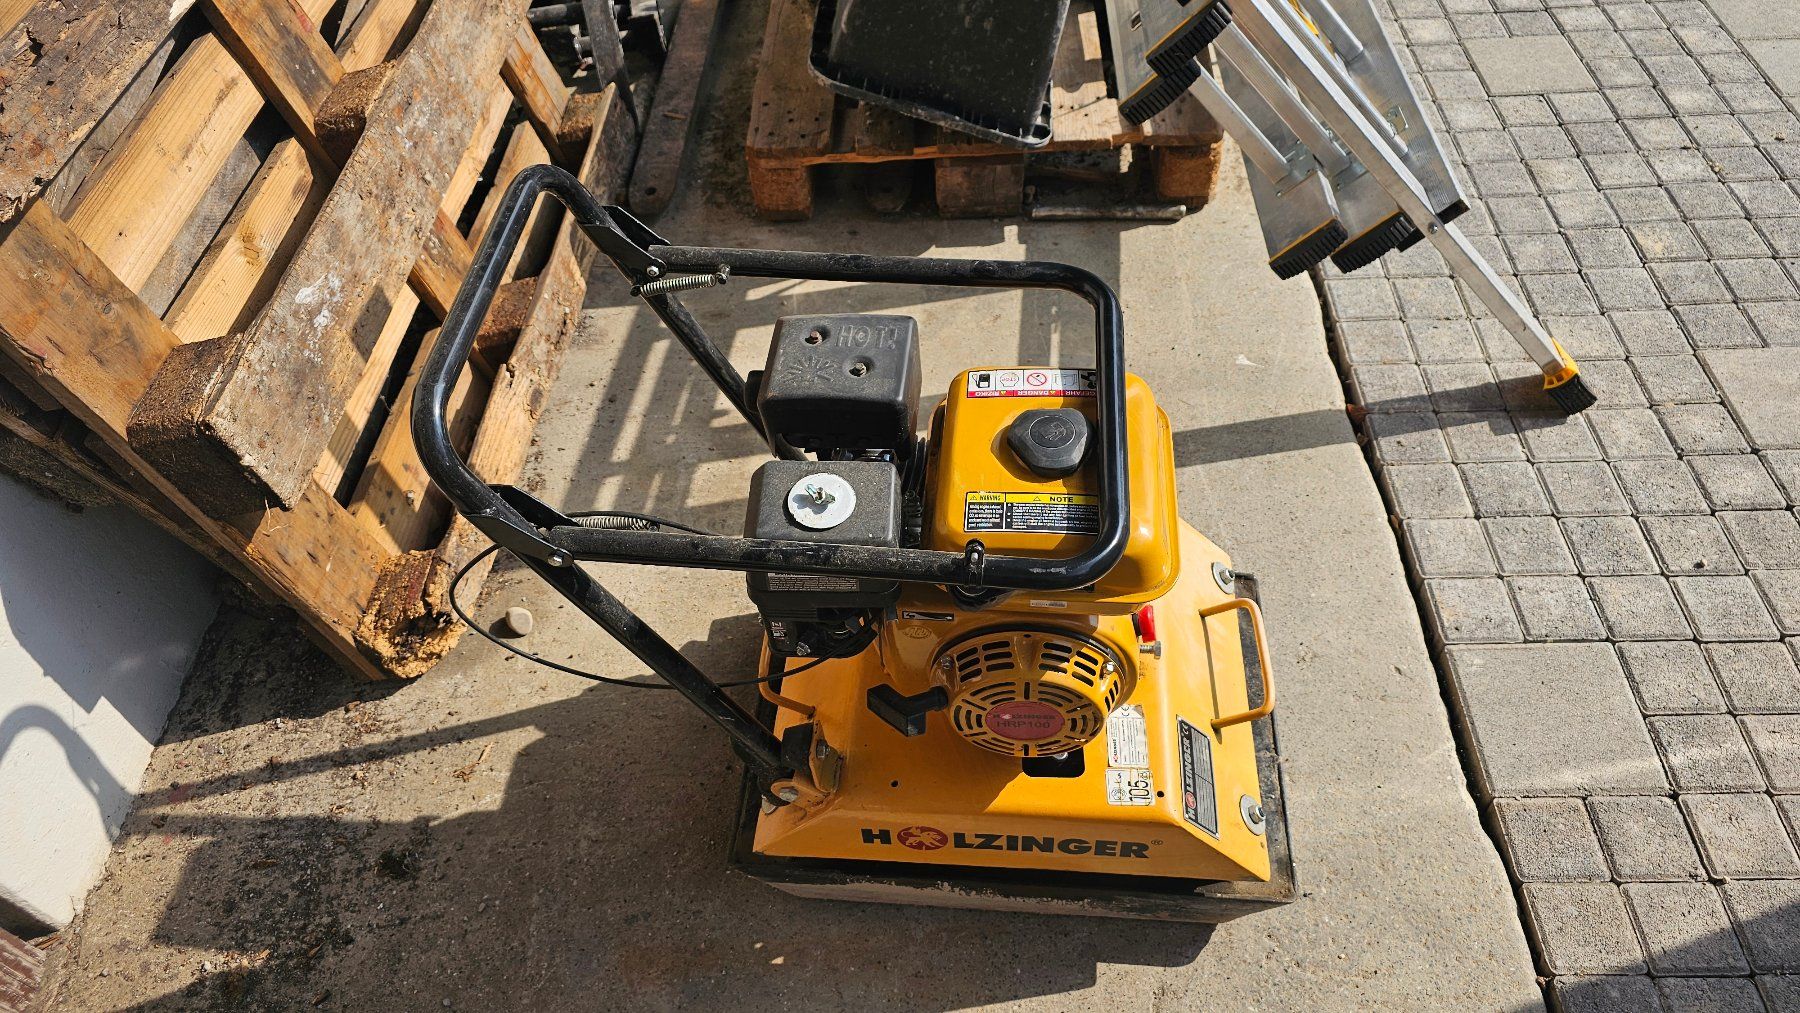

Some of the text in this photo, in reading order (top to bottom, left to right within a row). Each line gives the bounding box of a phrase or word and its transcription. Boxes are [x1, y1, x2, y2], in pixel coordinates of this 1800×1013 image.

[835, 325, 898, 350] HOT!
[996, 720, 1050, 729] HRP100
[1127, 780, 1151, 802] 105
[1182, 738, 1197, 820] HOLZINGER
[860, 825, 1150, 859] HOLZINGER
